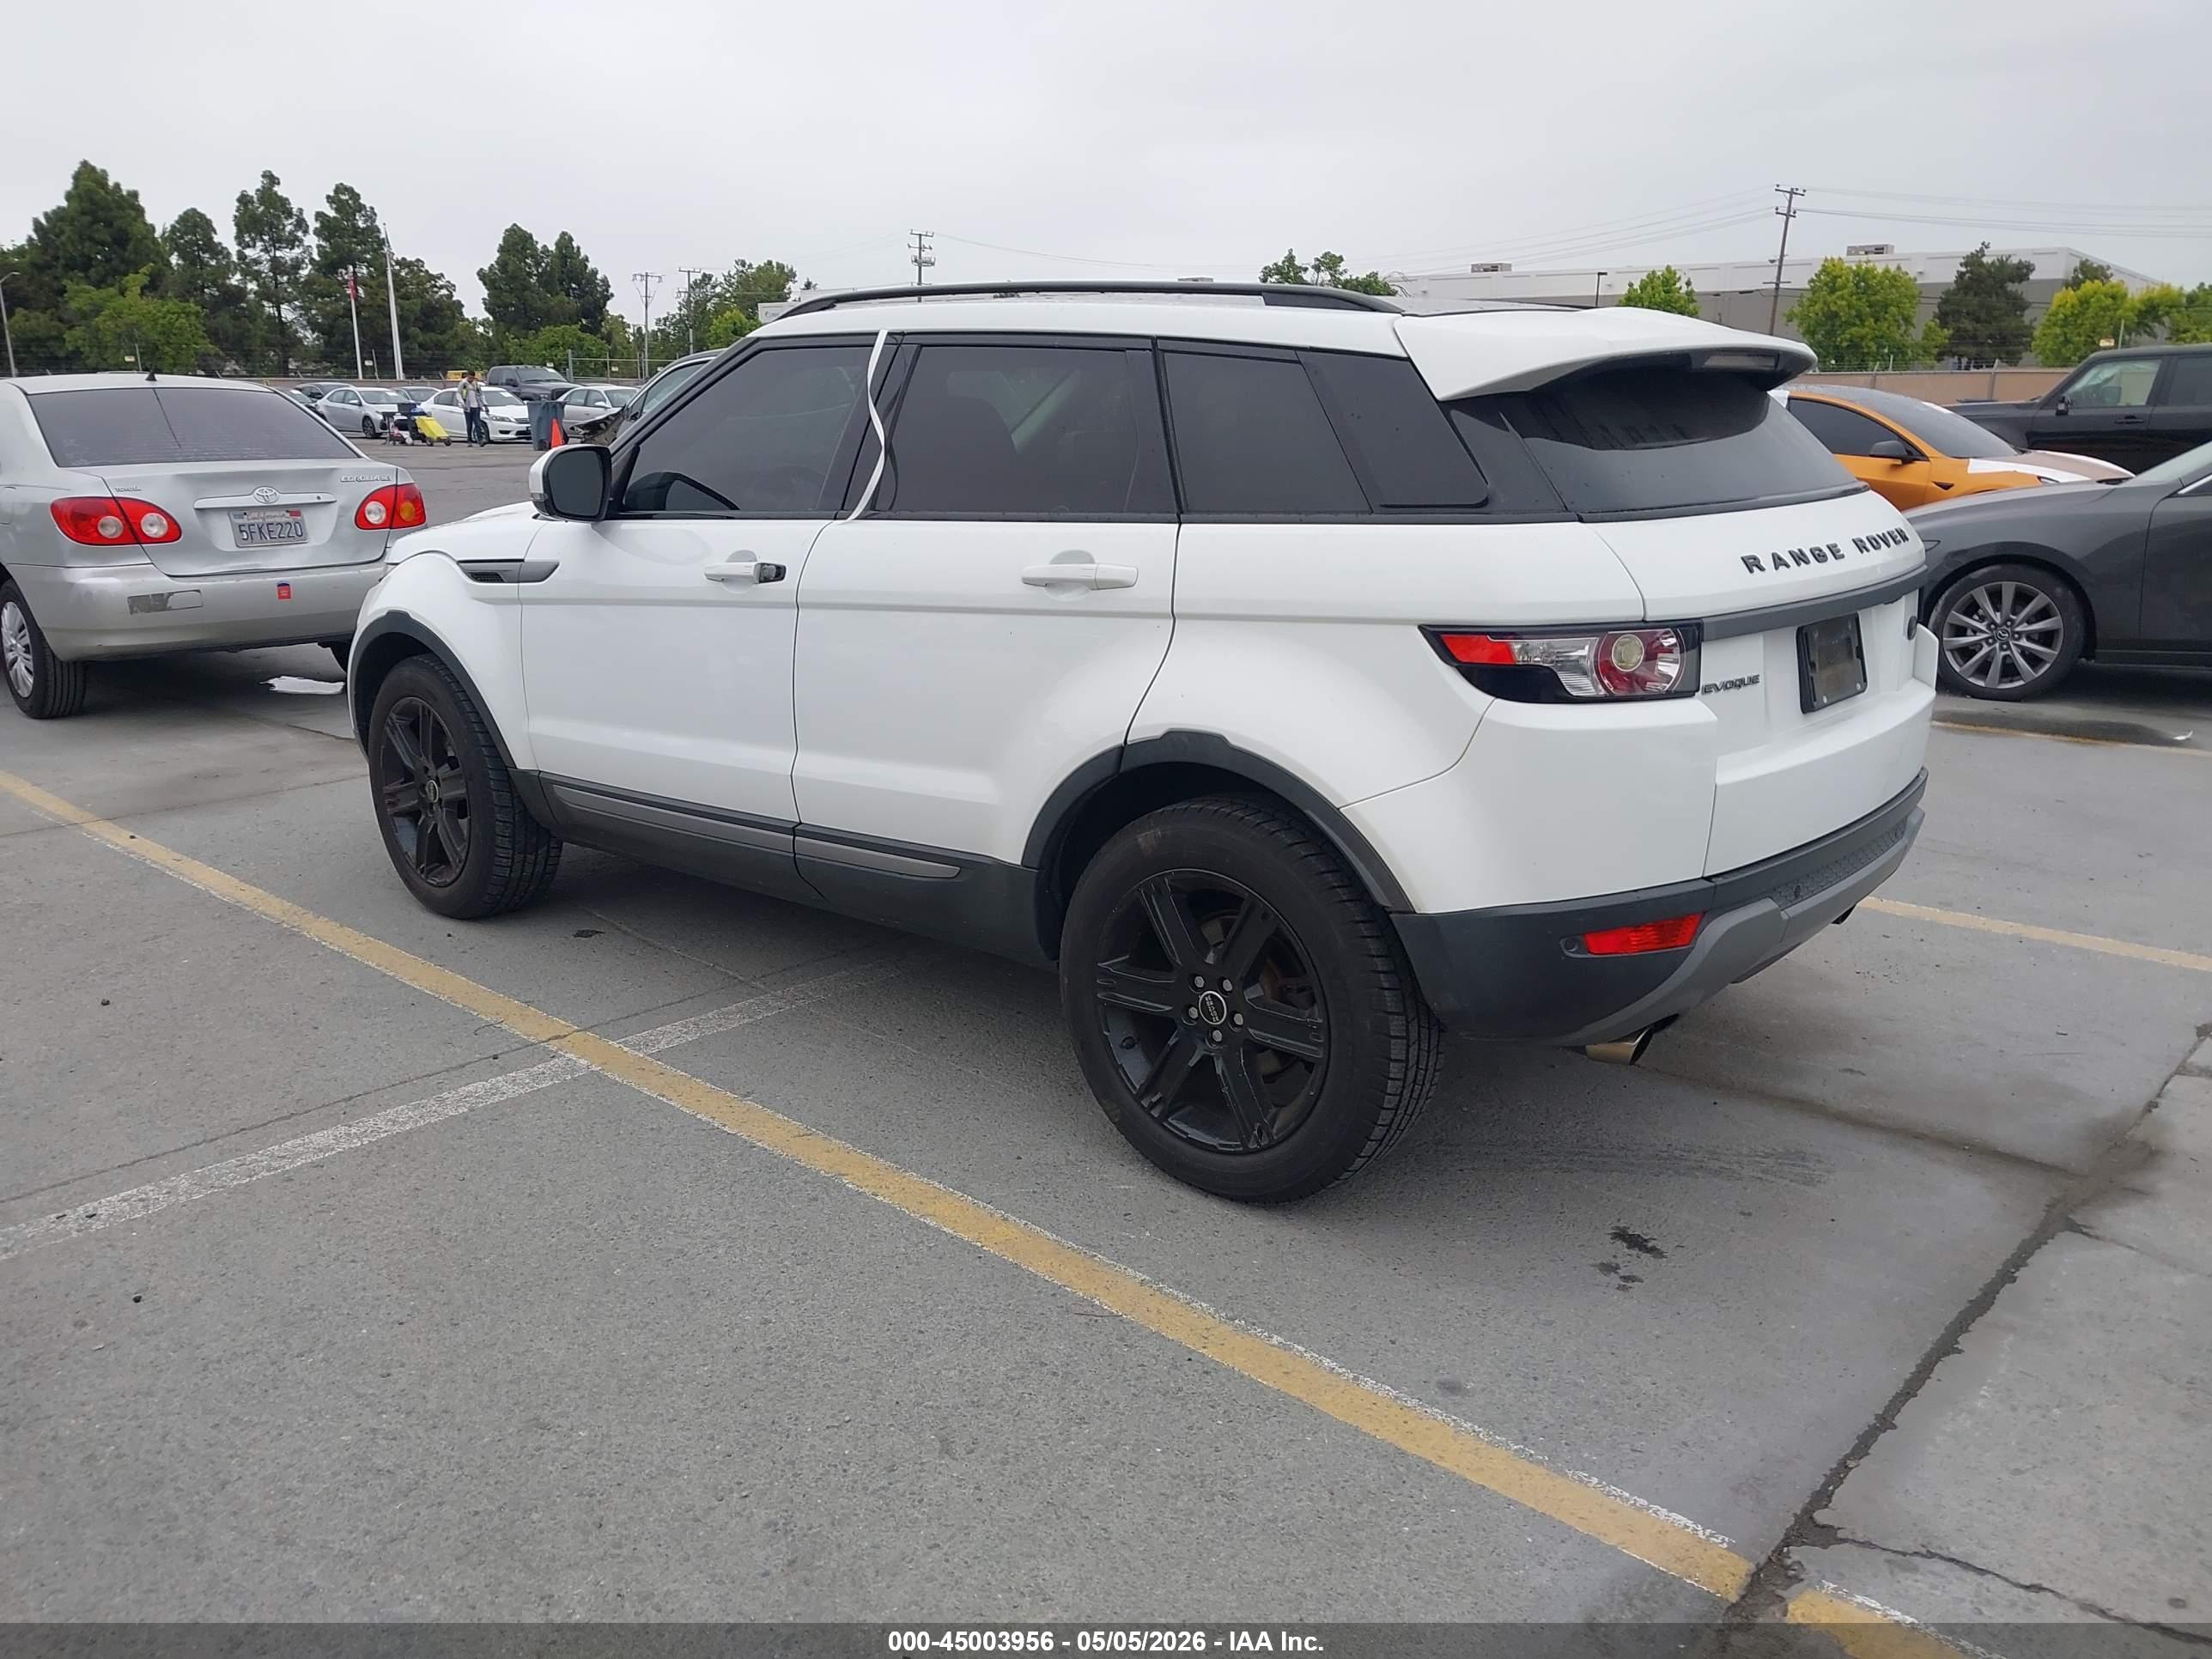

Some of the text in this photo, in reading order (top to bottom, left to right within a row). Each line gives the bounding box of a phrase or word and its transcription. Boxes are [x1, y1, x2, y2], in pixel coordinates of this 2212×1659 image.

[238, 521, 303, 541] 5FKE220
[1741, 526, 1910, 574] RANGE ROVER
[1701, 674, 1760, 695] EVOQUE
